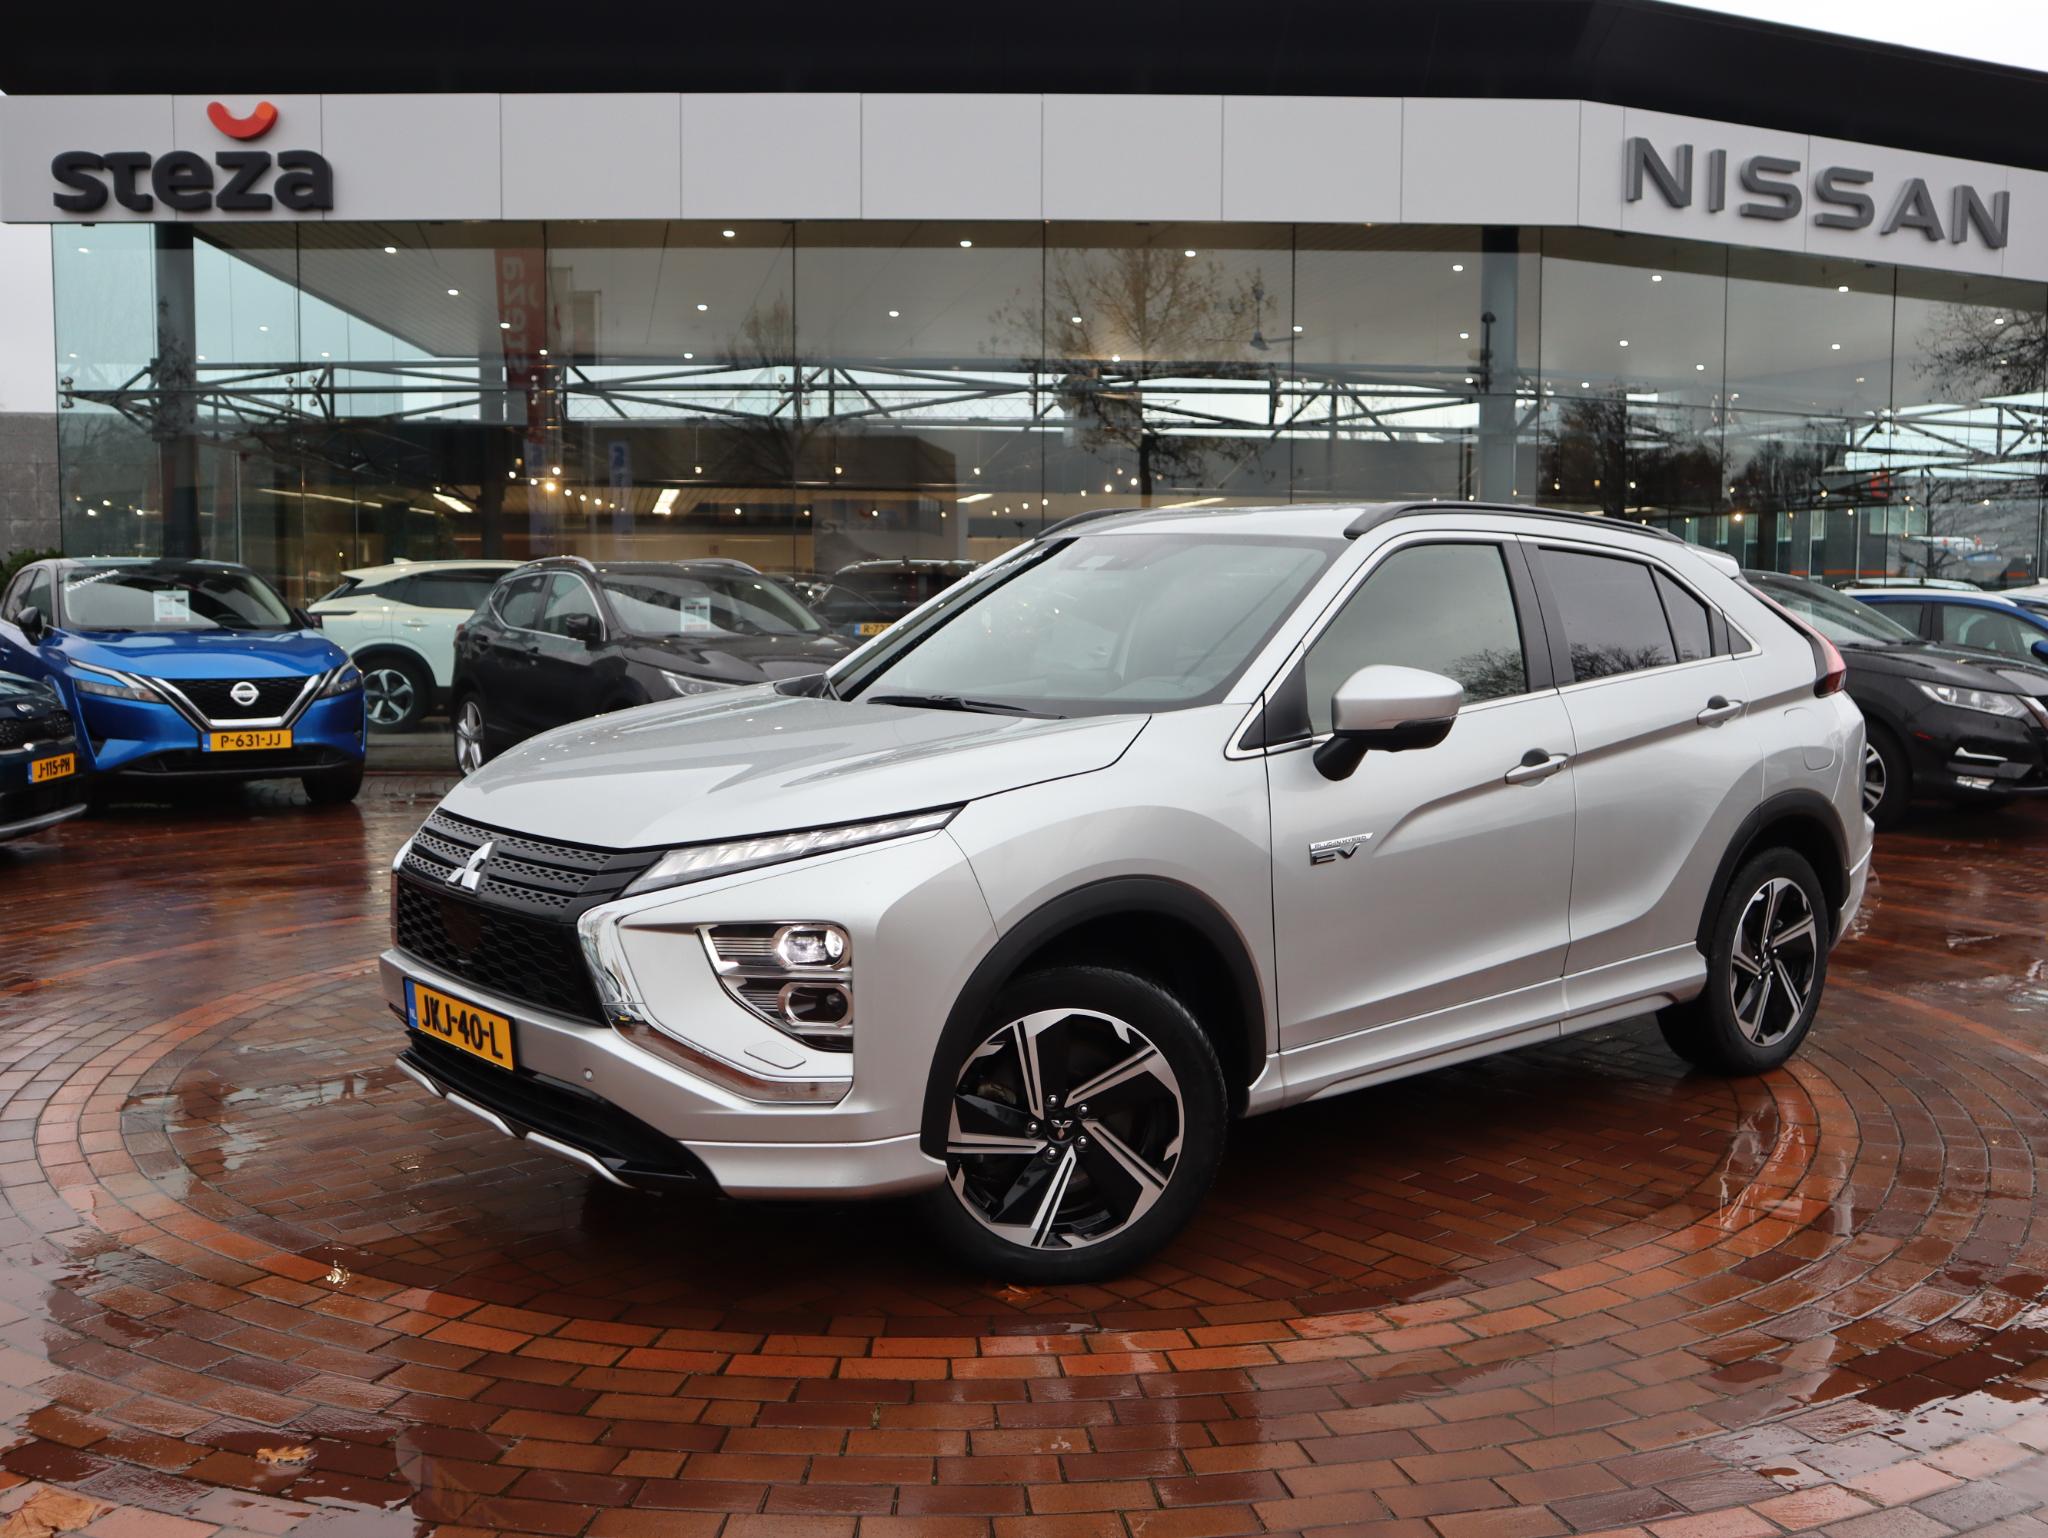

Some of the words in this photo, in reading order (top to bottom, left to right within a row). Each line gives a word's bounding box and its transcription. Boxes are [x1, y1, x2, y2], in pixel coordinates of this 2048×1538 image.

[1626, 136, 2010, 250] NISSAN
[220, 733, 282, 748] P-631-JJ
[1310, 842, 1361, 867] EV
[422, 994, 504, 1060] JKJ-40-L
